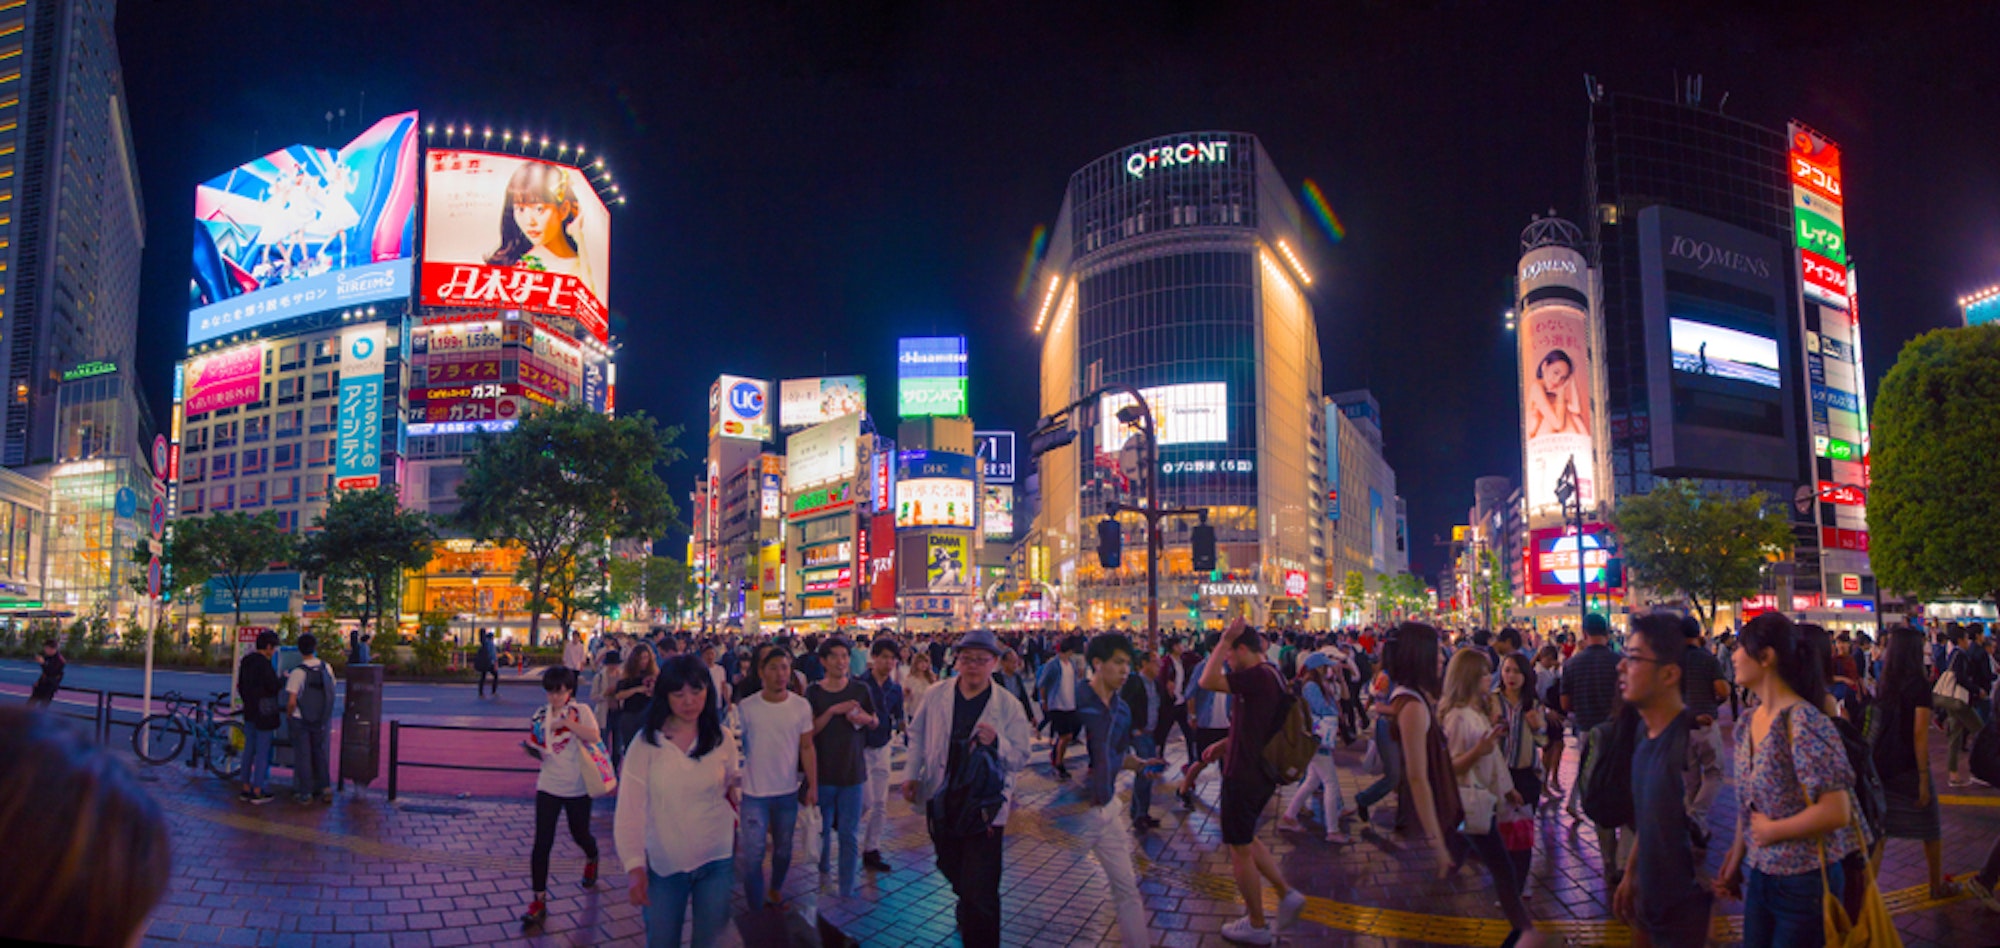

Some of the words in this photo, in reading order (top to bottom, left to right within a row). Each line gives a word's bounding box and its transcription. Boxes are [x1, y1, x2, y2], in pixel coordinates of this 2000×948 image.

[1126, 140, 1228, 179] QFRONT
[1796, 158, 1841, 196] アコム
[1800, 219, 1841, 250] レイク
[336, 268, 395, 296] KIREIMO
[1803, 258, 1846, 287] アイフル
[200, 287, 328, 331] あなたを想う脱毛サロン
[471, 383, 507, 399] ガスト
[732, 388, 765, 412] UC
[902, 387, 965, 404] サロンパス
[361, 382, 378, 468] コンタクトの
[449, 403, 493, 421] ガスト
[342, 384, 362, 469] アイシティ
[998, 462, 1012, 475] 21
[929, 535, 961, 547] DMM
[1200, 582, 1259, 596] TSUTAYA
